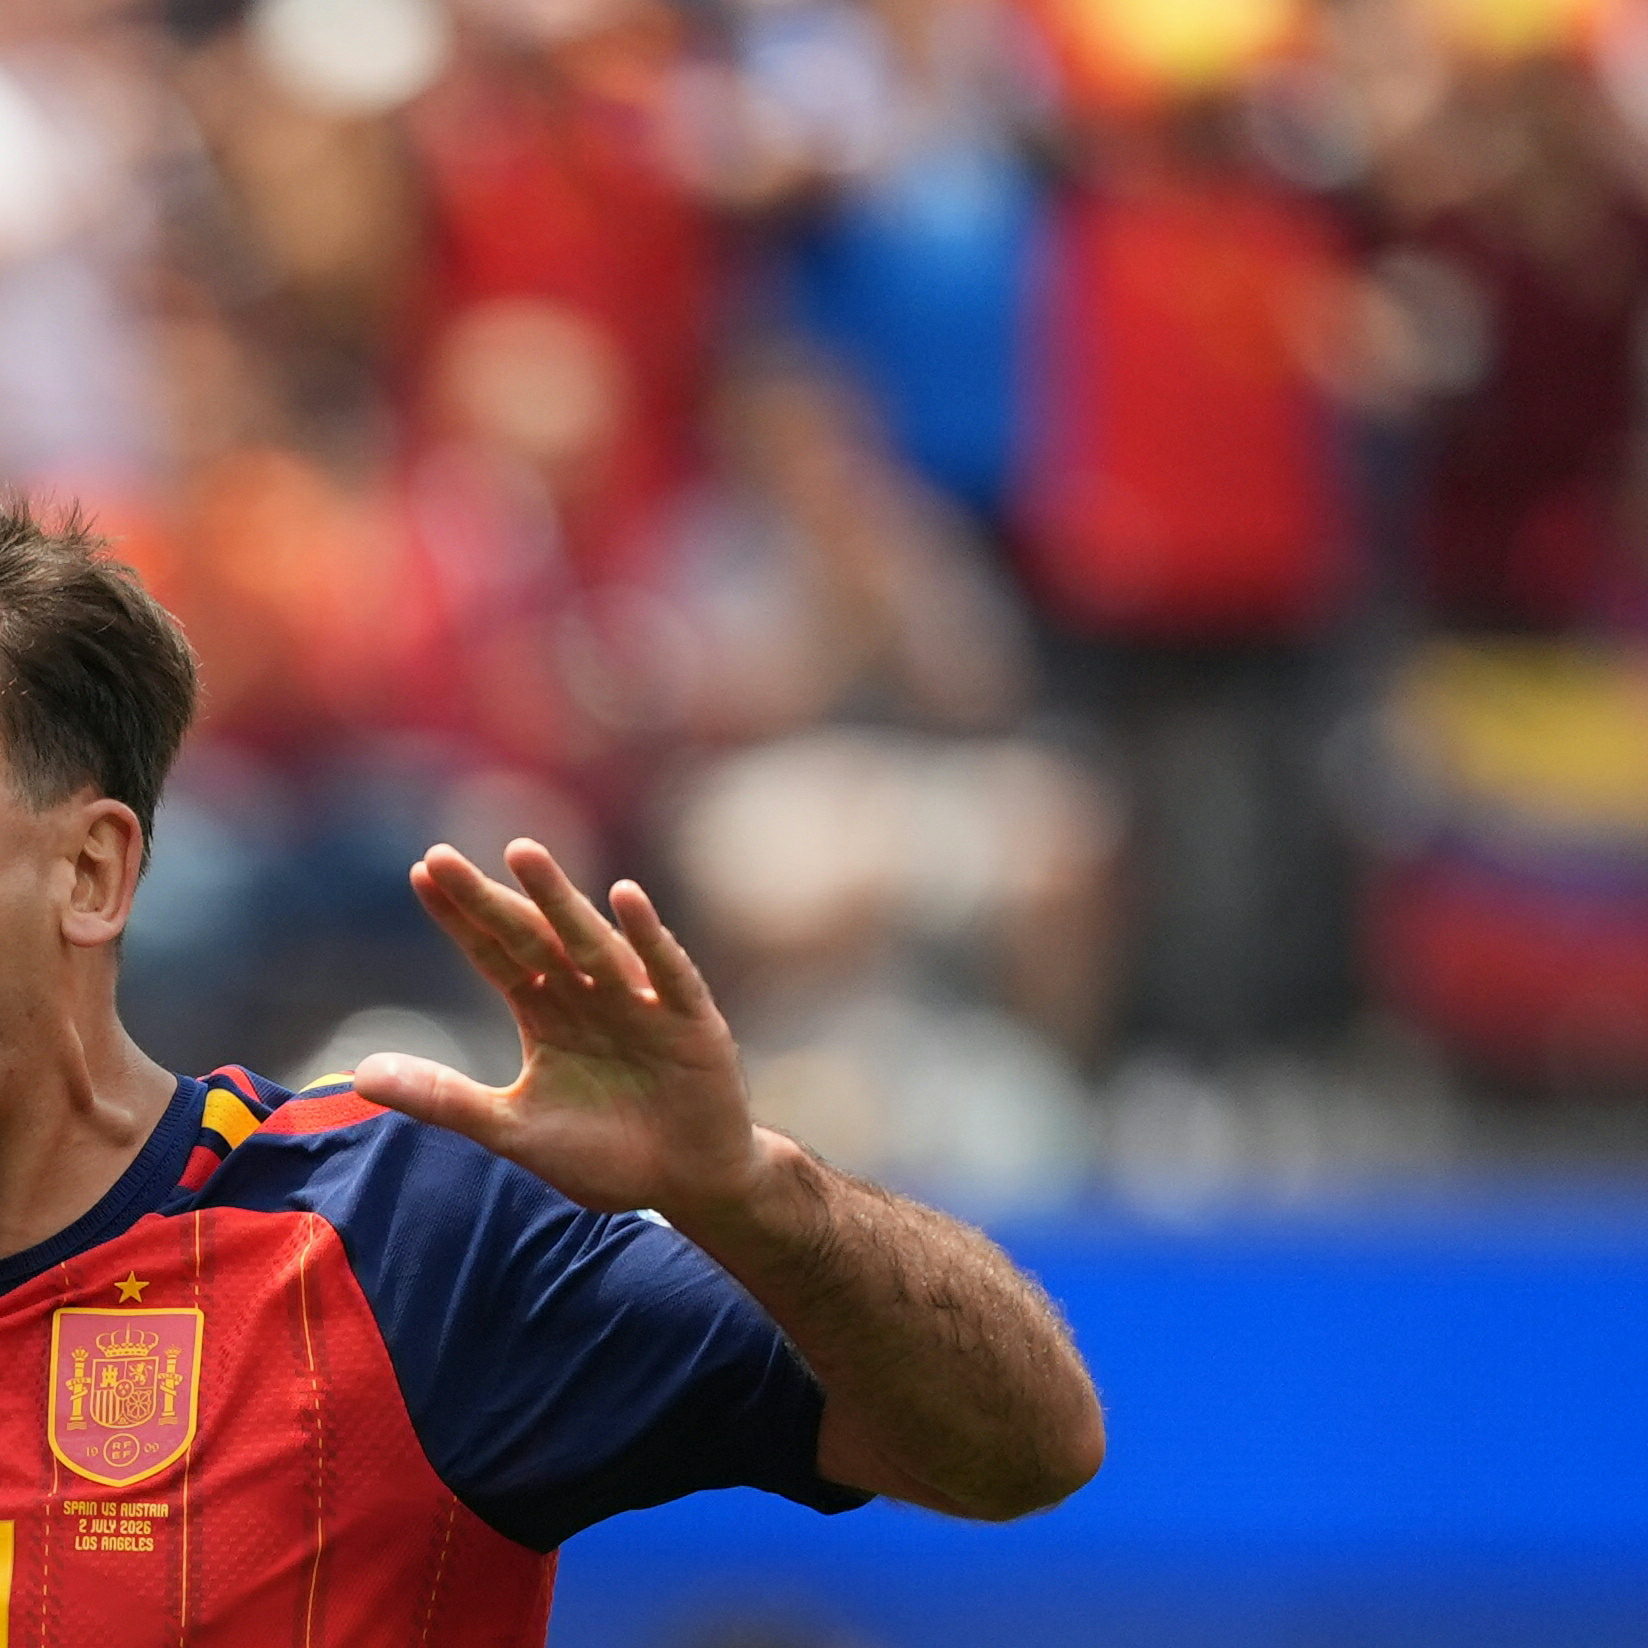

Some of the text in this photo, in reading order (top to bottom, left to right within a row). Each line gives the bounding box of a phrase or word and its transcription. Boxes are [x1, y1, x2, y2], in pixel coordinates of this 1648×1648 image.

[63, 1501, 97, 1516] SPAIN
[120, 1502, 169, 1518] AUSTRIA
[79, 1518, 152, 1535] 2 JULY 2026
[75, 1535, 154, 1552] LOS ANGELES
